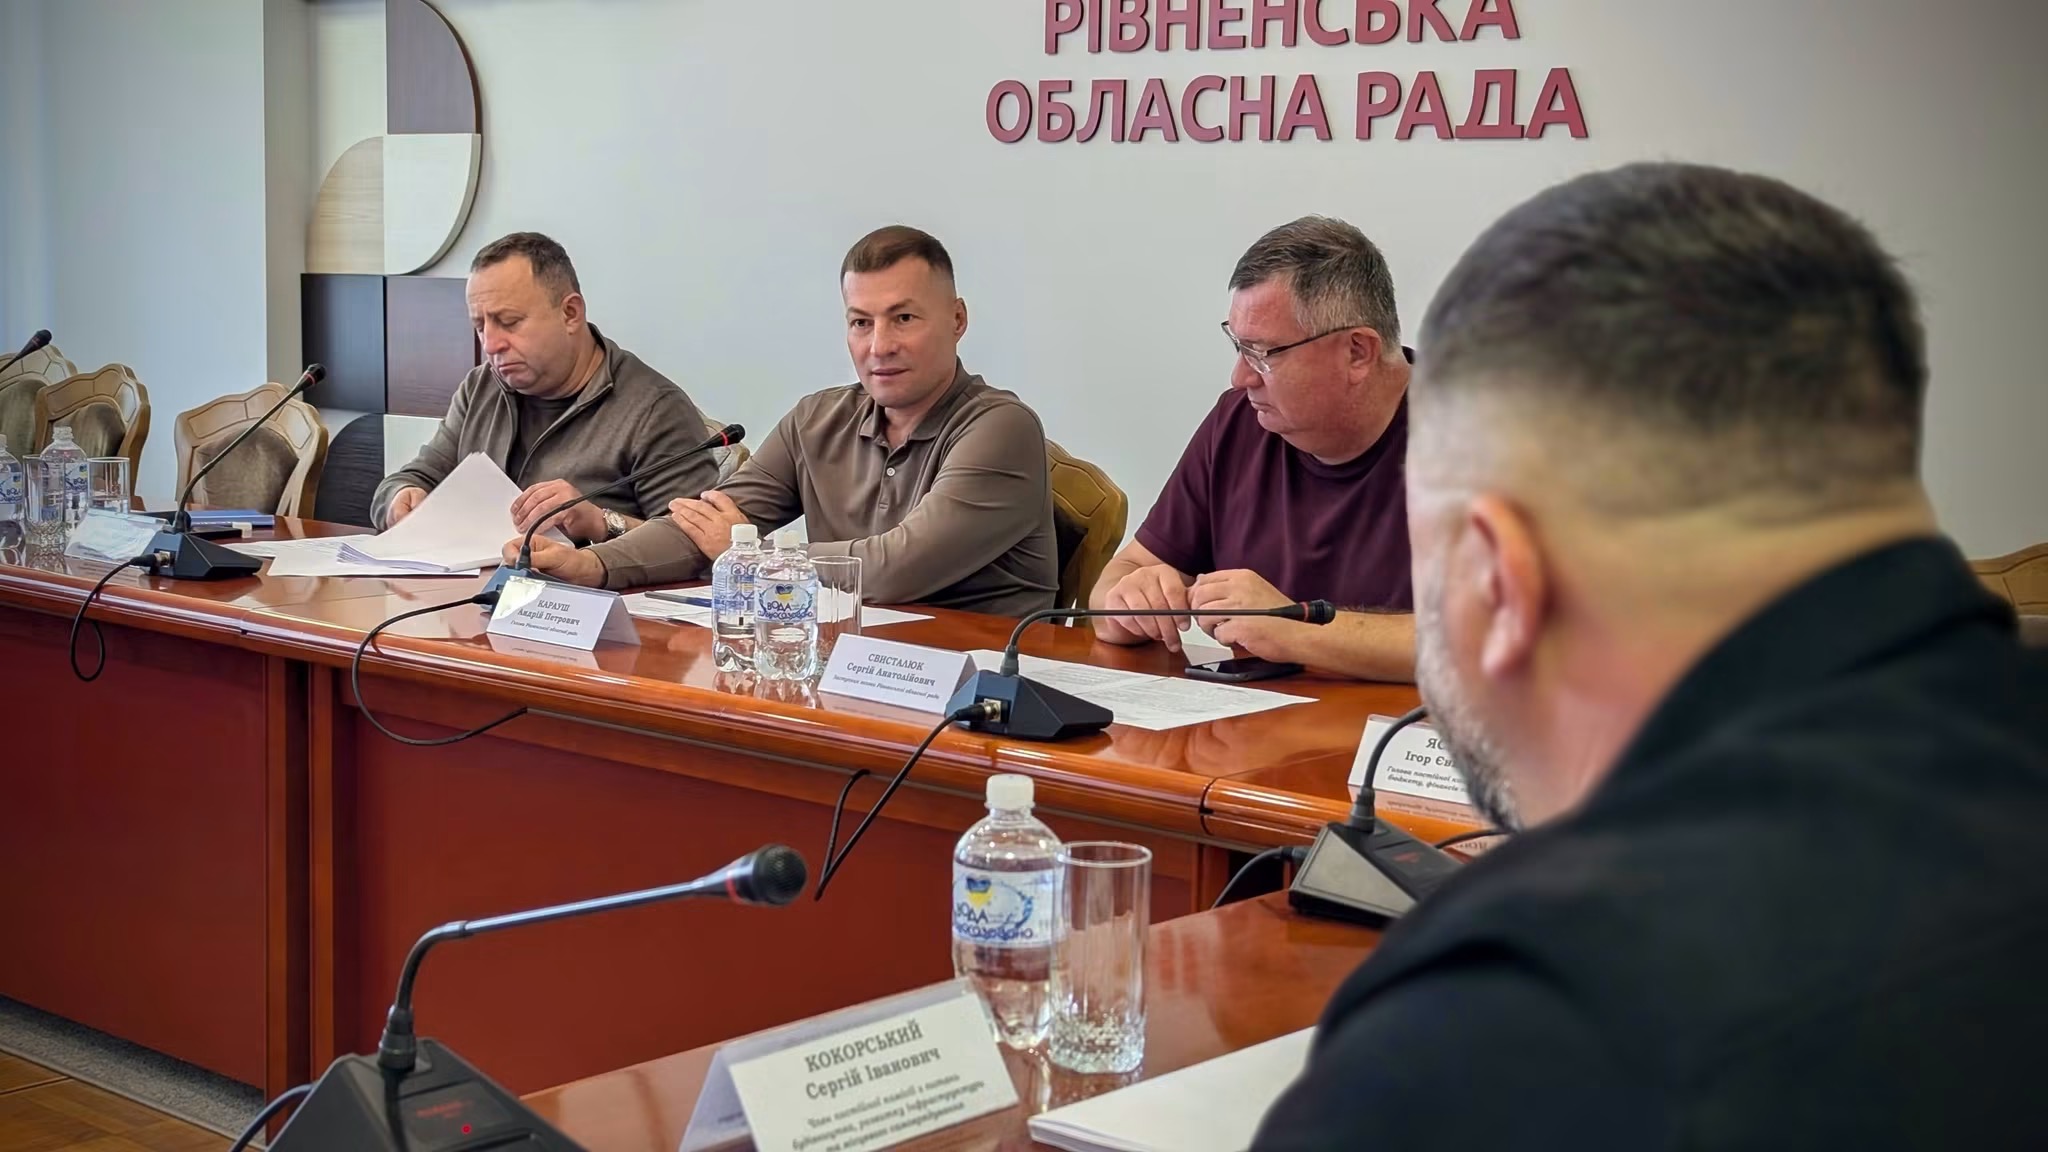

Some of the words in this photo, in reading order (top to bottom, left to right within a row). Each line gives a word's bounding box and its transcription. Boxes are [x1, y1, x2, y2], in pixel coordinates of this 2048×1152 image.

[1044, 0, 1521, 54] РІВНЕНСЬКА
[985, 74, 1333, 143] ОБЛАСНА
[1356, 67, 1588, 141] РАДА
[537, 600, 571, 612] КАРАУШ
[767, 600, 792, 611] ВОДА
[518, 609, 544, 620] Андрій
[544, 612, 580, 625] Петрович
[868, 653, 924, 671] СВИСТАЛЮК
[847, 662, 875, 675] Сергій
[876, 667, 936, 687] Анатолійович
[1425, 738, 1447, 750] ЯС
[1405, 751, 1431, 766] Ігор
[805, 1018, 923, 1073] КОКОРСЬКИЙ
[806, 1067, 863, 1100] Сергій
[865, 1047, 941, 1081] Іванович
